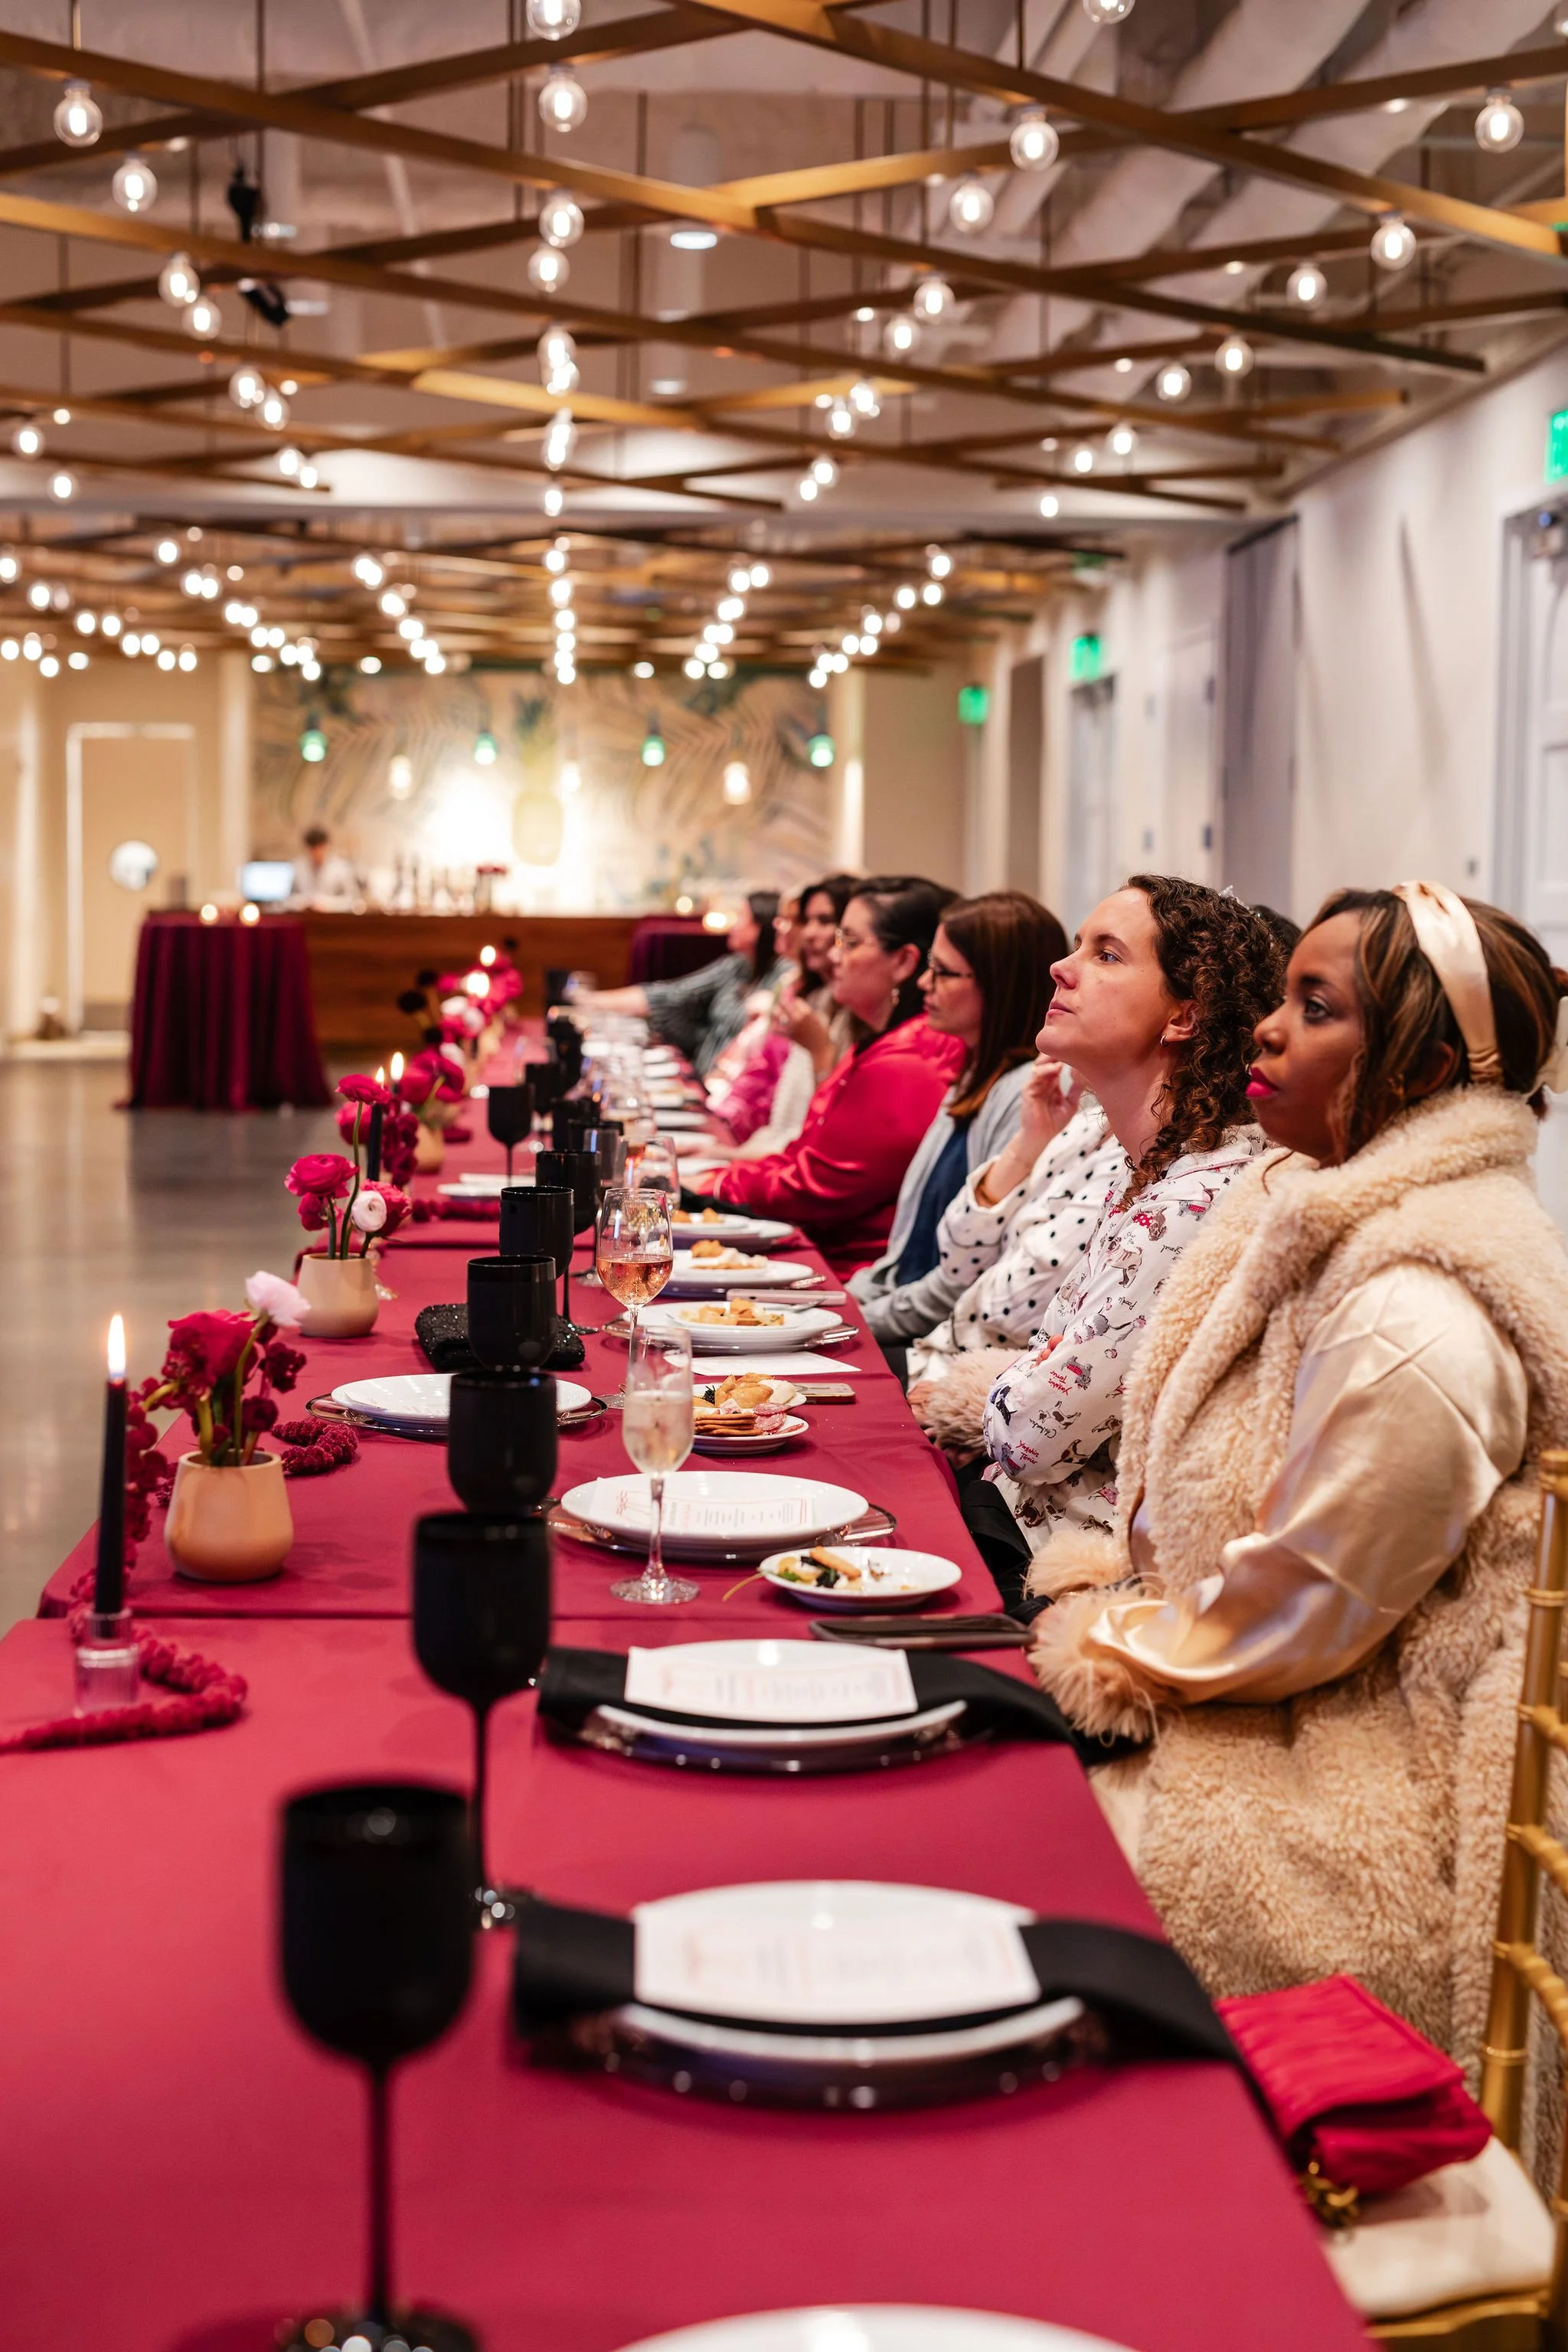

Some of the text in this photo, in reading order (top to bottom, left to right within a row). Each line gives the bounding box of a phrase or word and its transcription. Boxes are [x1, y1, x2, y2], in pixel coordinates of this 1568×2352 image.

[1118, 1296, 1138, 1311] Poodle
[1050, 1370, 1067, 1383] Terrier
[1020, 1452, 1038, 1465] Terrier
